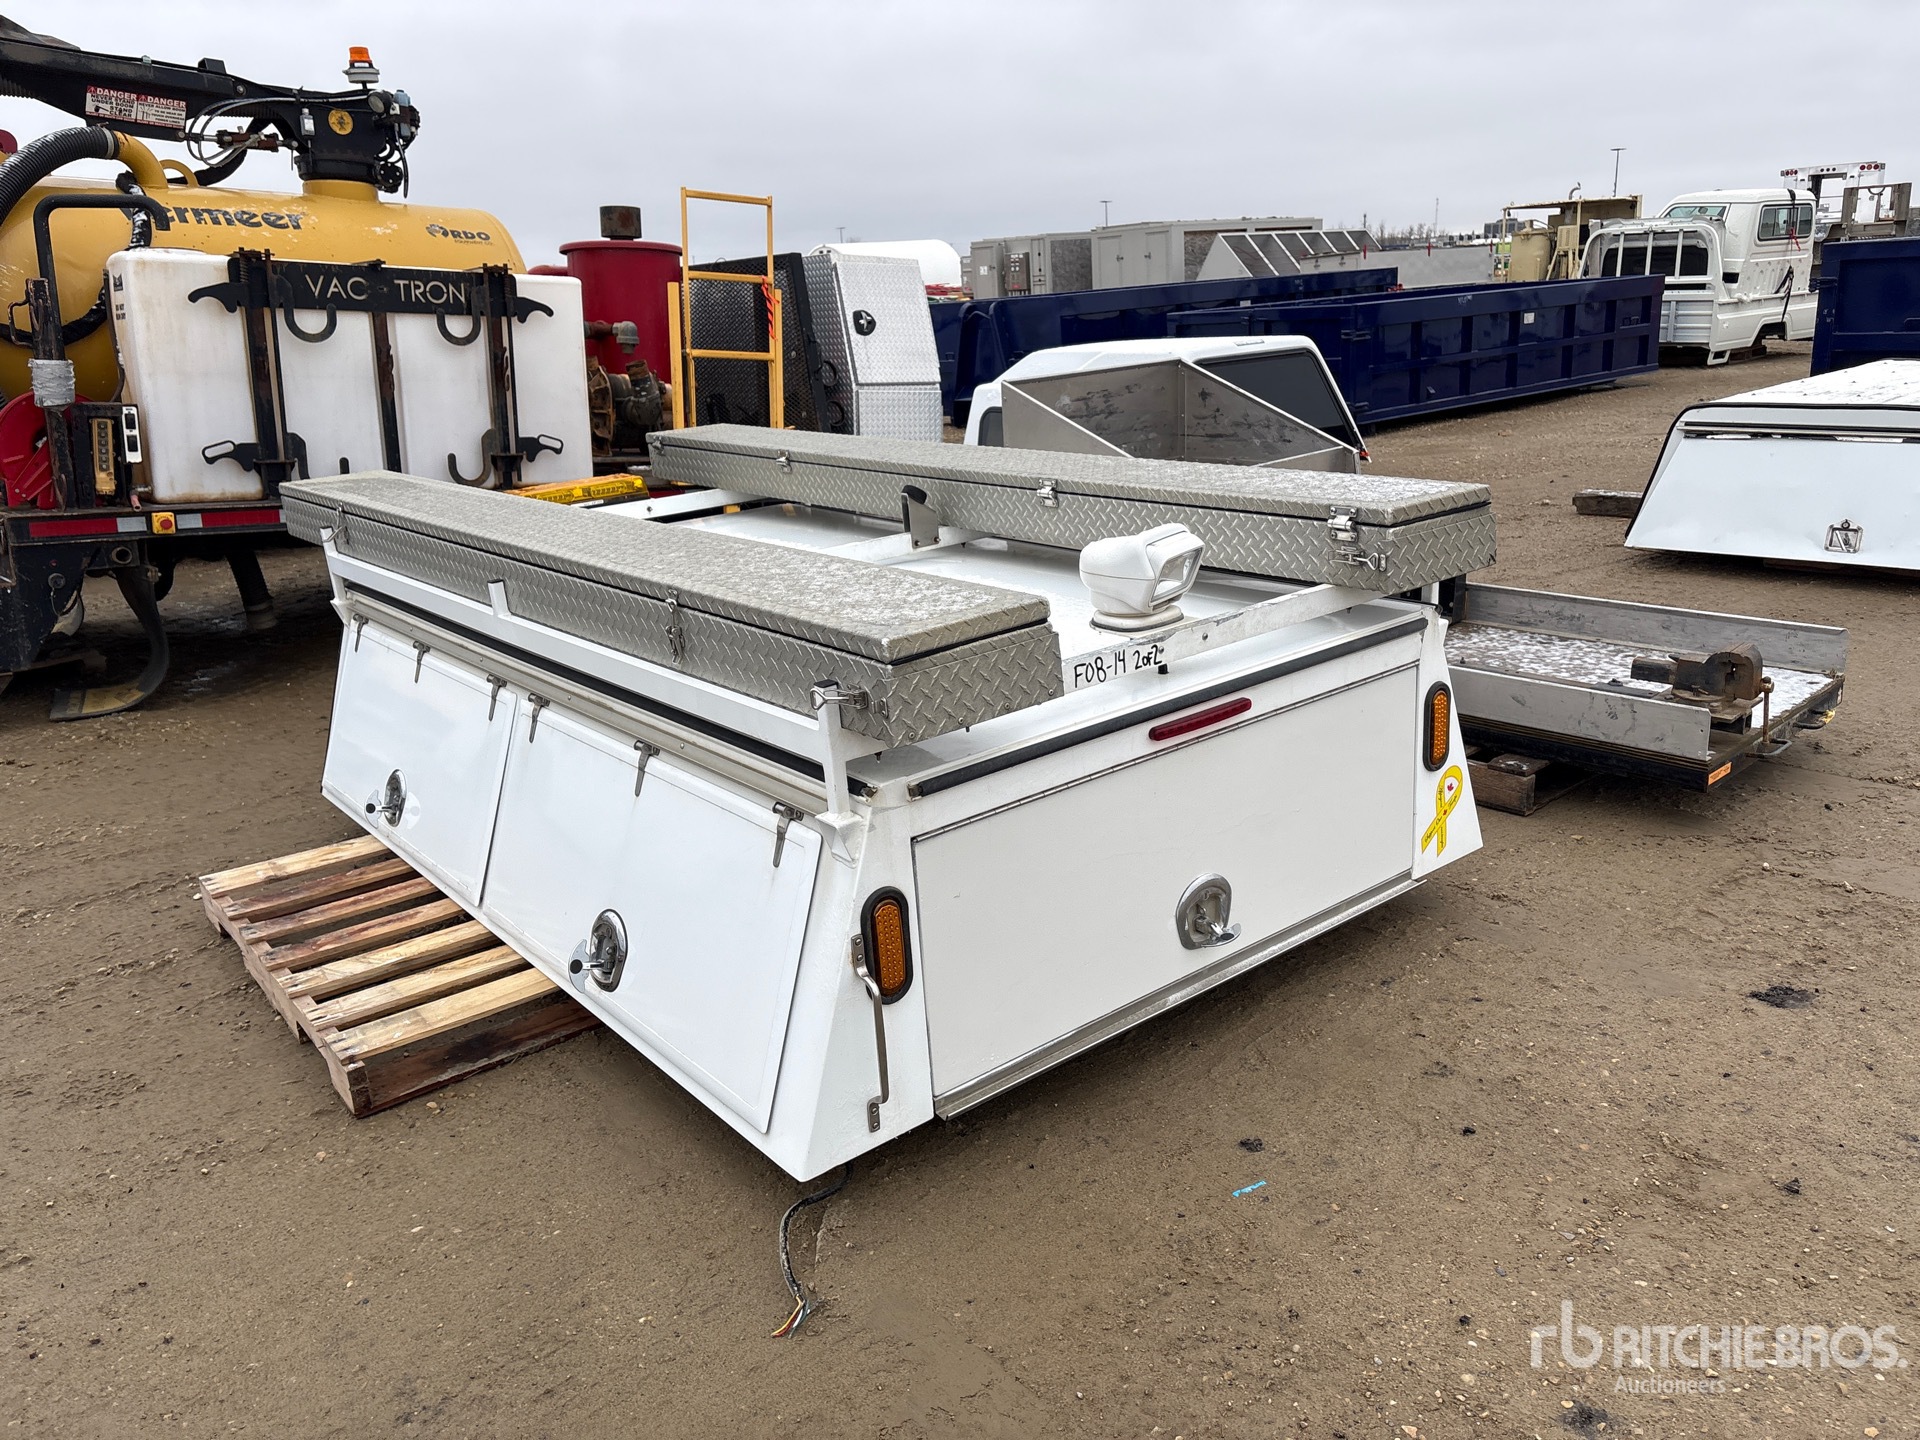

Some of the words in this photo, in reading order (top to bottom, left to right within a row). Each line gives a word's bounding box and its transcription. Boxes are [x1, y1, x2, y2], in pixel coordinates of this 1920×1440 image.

[96, 87, 138, 101] DANGER
[91, 98, 114, 106] UNDER
[115, 101, 134, 109] BOOM
[147, 96, 187, 108] DANGER
[109, 105, 133, 114] STAND
[305, 274, 369, 300] VAC
[394, 279, 466, 304] TRON
